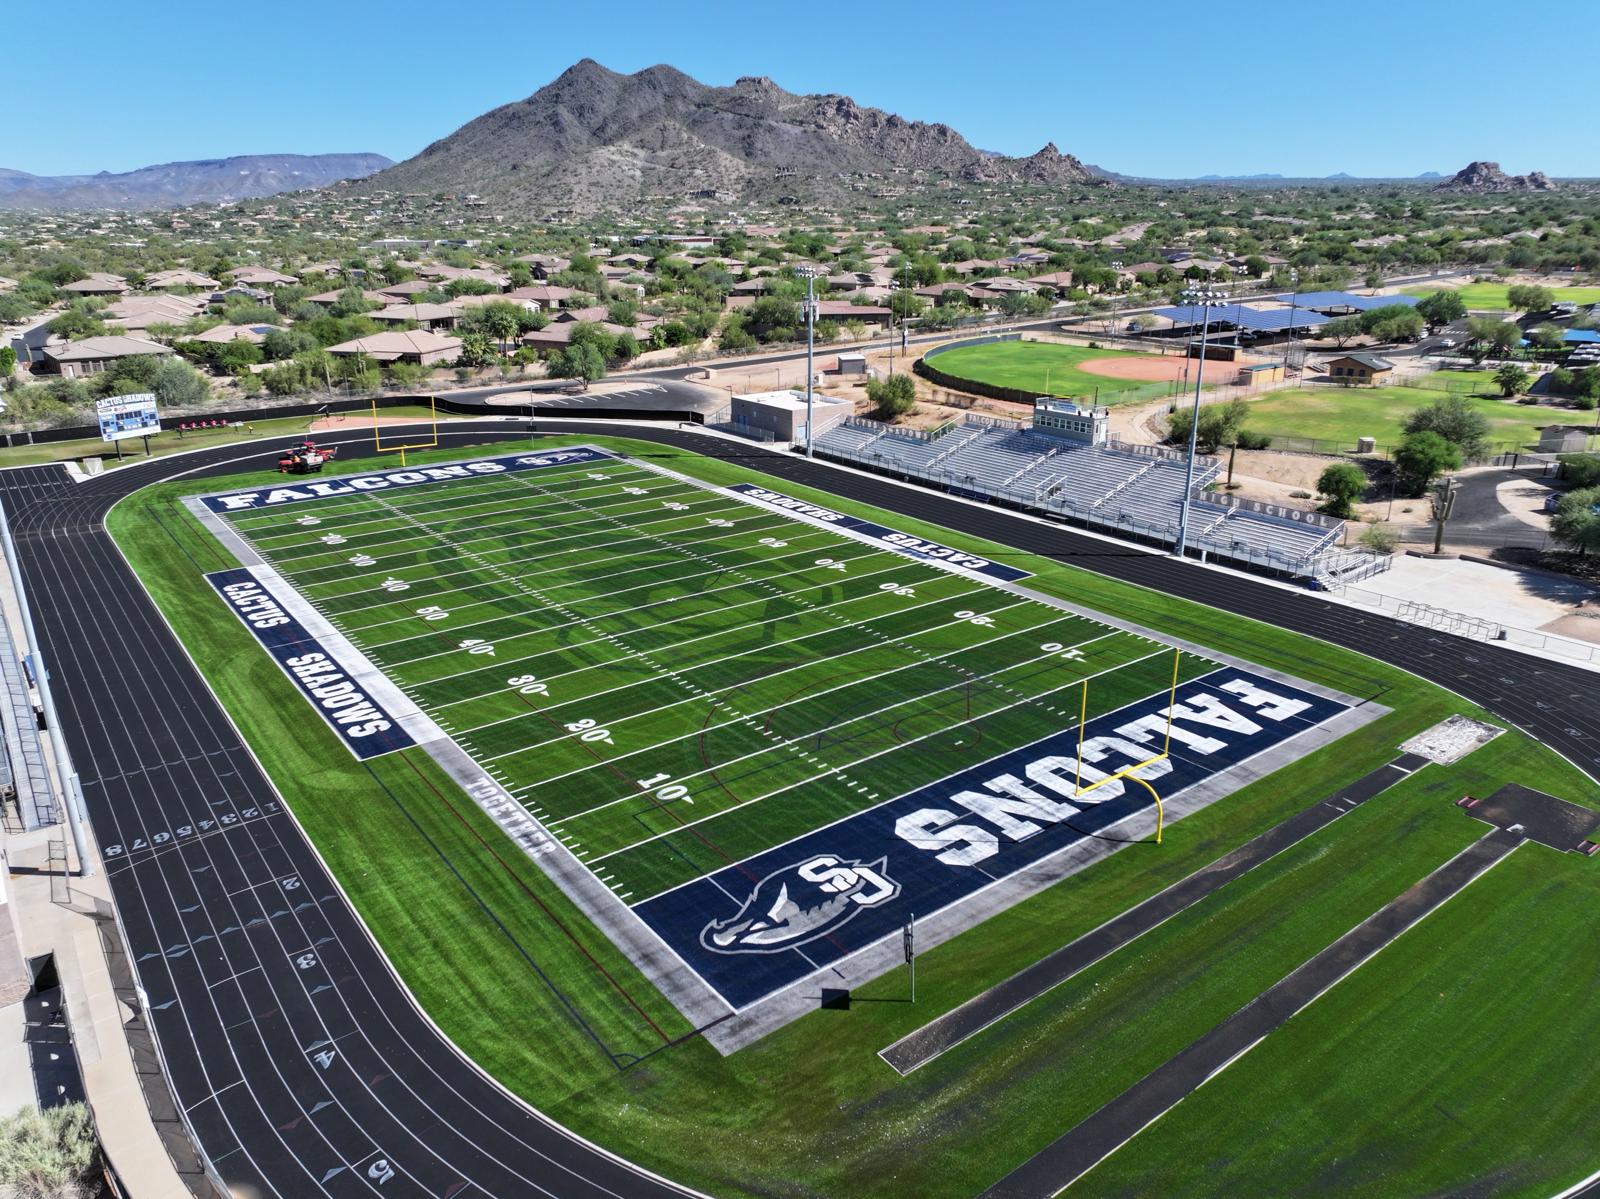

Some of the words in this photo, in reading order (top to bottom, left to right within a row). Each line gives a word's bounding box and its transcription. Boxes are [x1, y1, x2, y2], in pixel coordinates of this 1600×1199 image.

[96, 396, 122, 409] CACTUS
[217, 461, 507, 510] FALCONS
[743, 488, 846, 522] SHADOWS
[1200, 490, 1240, 507] HIGH
[1252, 502, 1328, 527] SCHOOL
[881, 532, 990, 569] CACTUS
[416, 605, 450, 622] 50
[458, 638, 494, 656] 40
[1039, 642, 1085, 659] 10
[222, 581, 291, 629] CACTUS
[285, 652, 392, 738] SHADOWS
[507, 674, 548, 696] 30
[564, 718, 611, 744] 20
[893, 678, 1313, 868] FALCONS
[636, 772, 689, 802] 10
[220, 812, 238, 824] 3
[241, 806, 259, 818] 2
[464, 776, 557, 859] TOGETHER
[176, 825, 193, 837] 5
[198, 819, 215, 831] 4
[132, 838, 148, 850] 7
[152, 832, 171, 844] 6
[104, 844, 123, 857] 8
[282, 876, 301, 891] 2
[295, 952, 317, 970] 3
[313, 1048, 337, 1070] 4
[366, 1158, 396, 1185] 5
